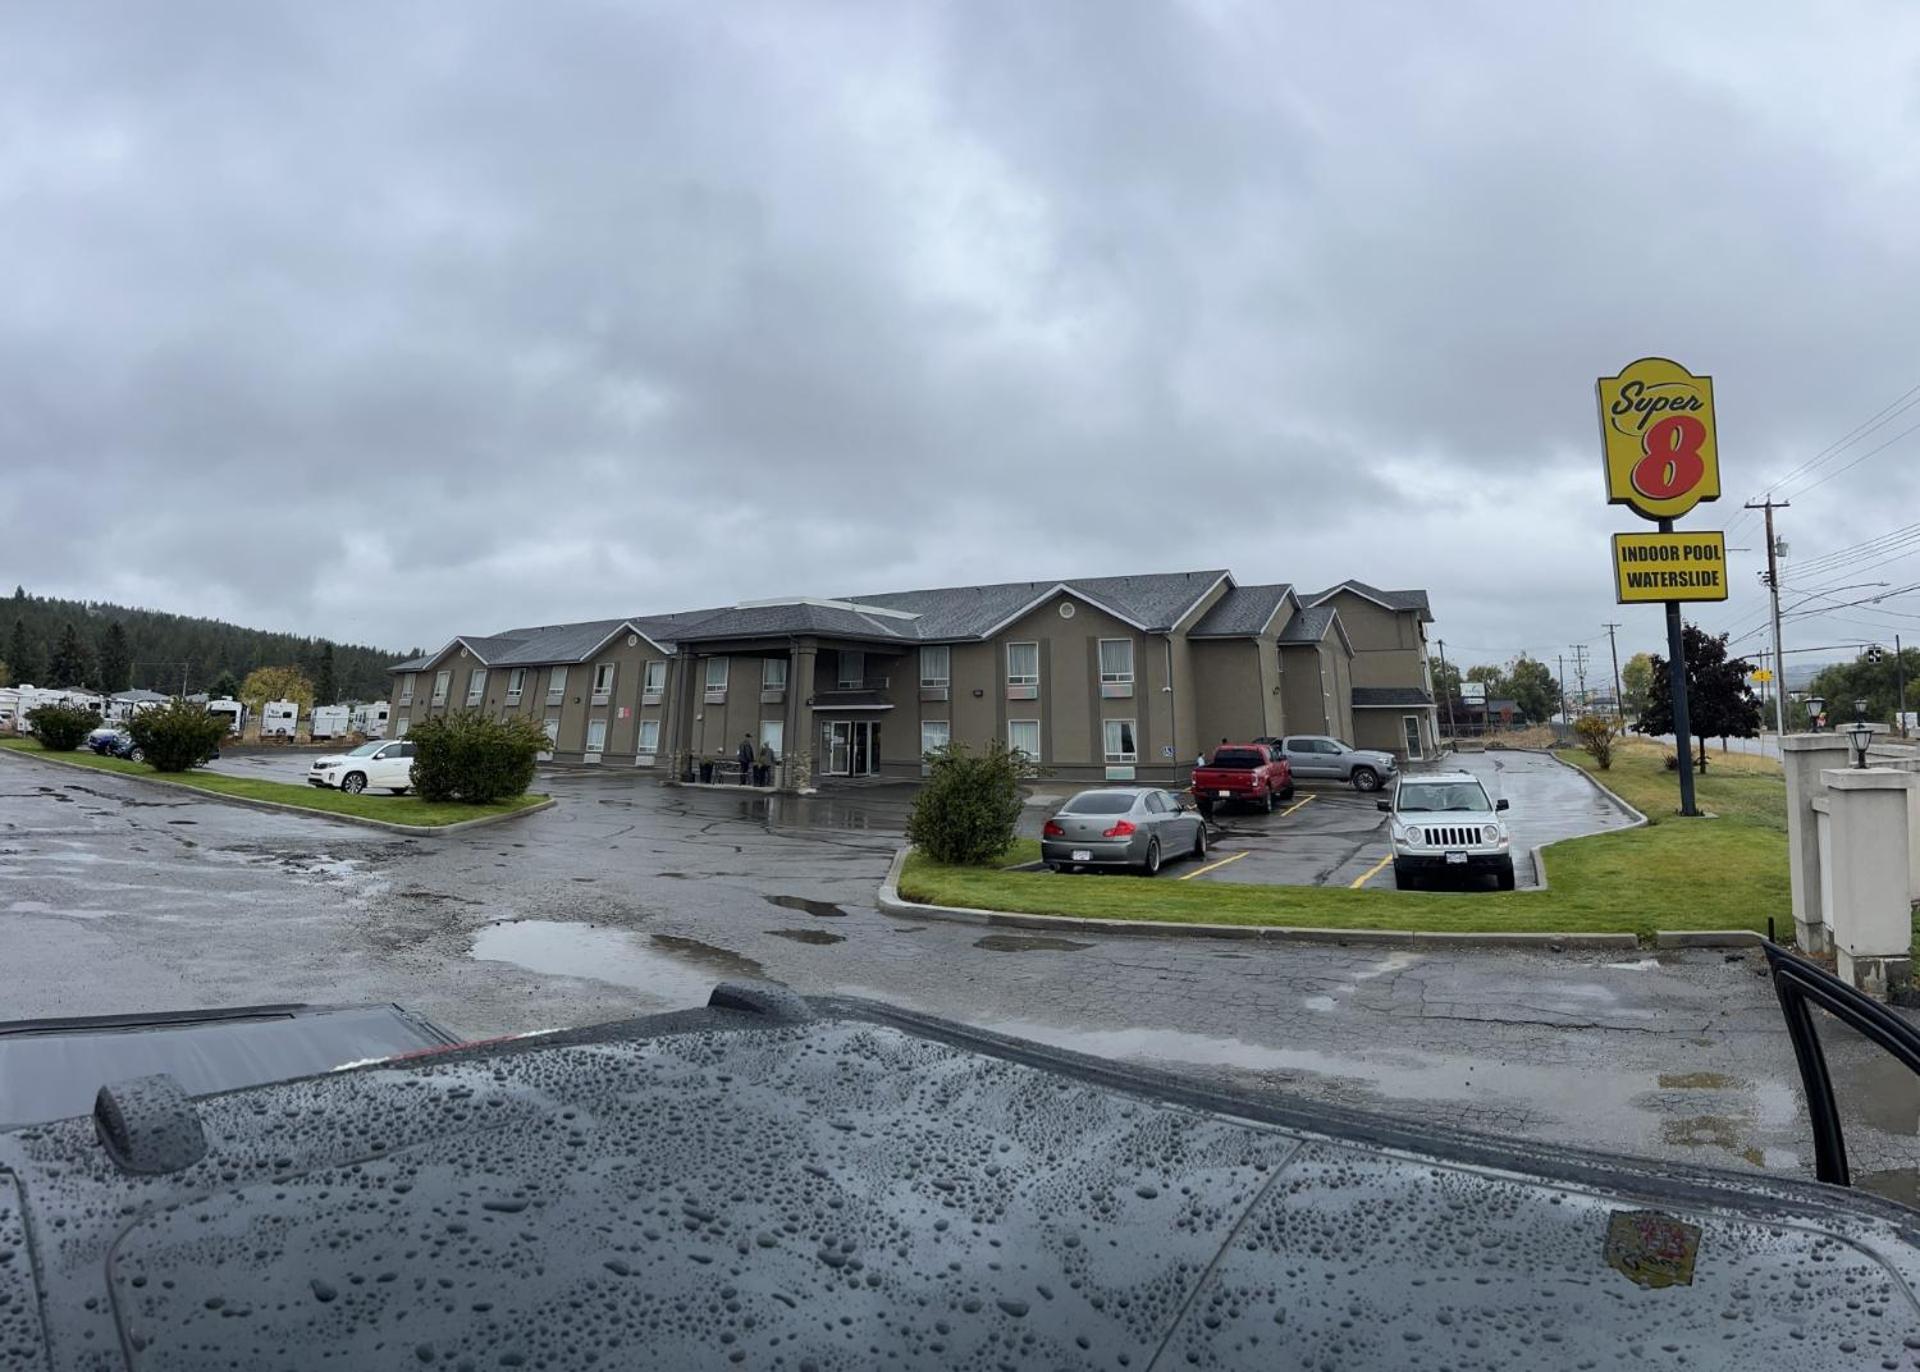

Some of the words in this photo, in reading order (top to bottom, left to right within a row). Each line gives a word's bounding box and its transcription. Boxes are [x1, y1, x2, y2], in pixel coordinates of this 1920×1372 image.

[1611, 380, 1704, 430] Super
[1630, 415, 1707, 500] 8
[1621, 545, 1680, 562] INDOOR
[1682, 544, 1721, 561] POOL
[1626, 570, 1720, 588] WATERSLIDE
